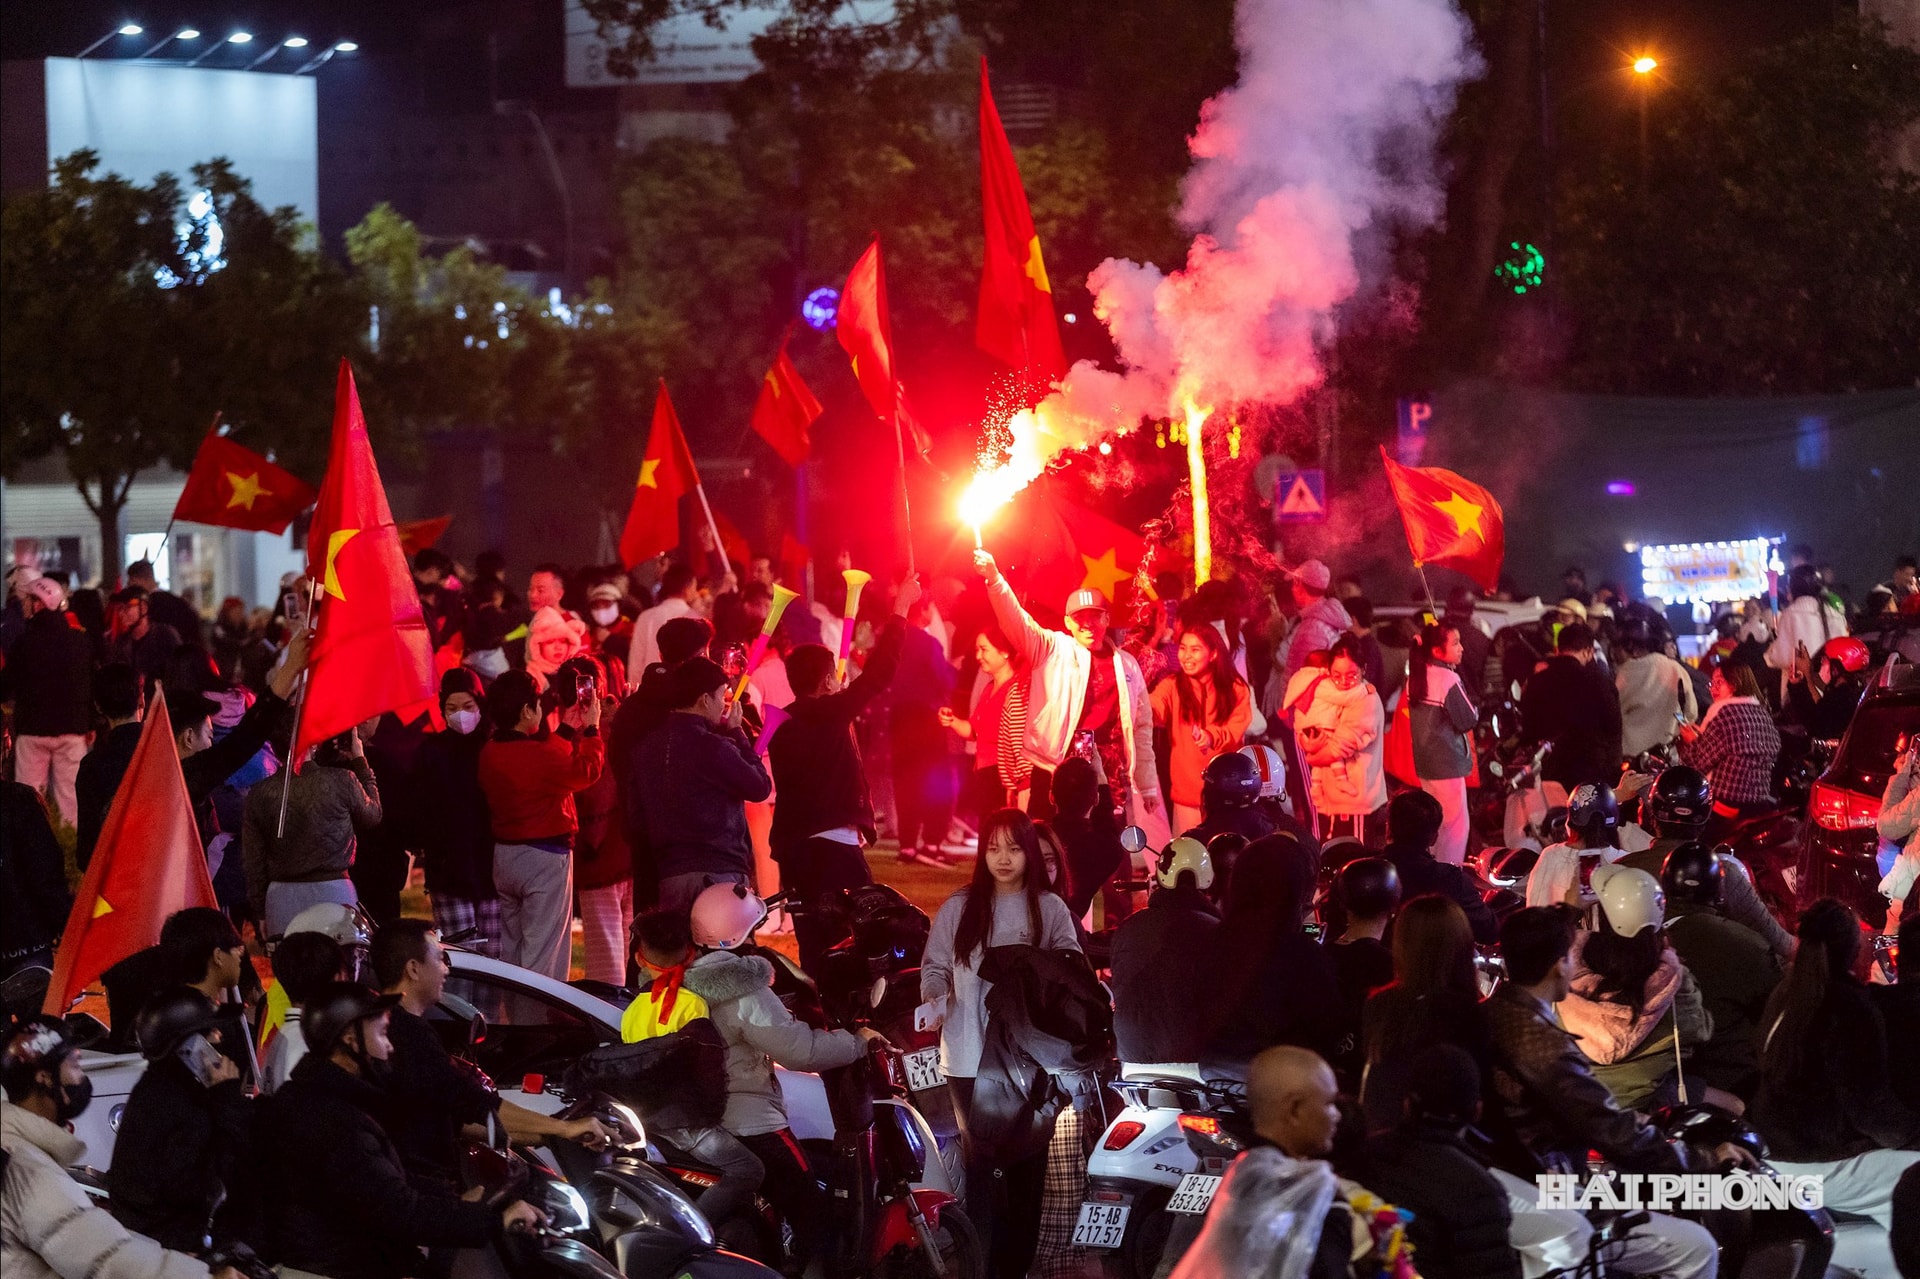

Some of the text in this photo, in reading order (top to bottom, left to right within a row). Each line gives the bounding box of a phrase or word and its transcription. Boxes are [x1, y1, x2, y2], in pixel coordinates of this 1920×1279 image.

[1410, 402, 1432, 430] P
[911, 1068, 943, 1087] 411.
[1184, 1176, 1216, 1193] 18-L1
[1169, 1193, 1210, 1211] 353.28
[1088, 1206, 1121, 1224] 15-AB
[1075, 1225, 1121, 1244] 217.57
